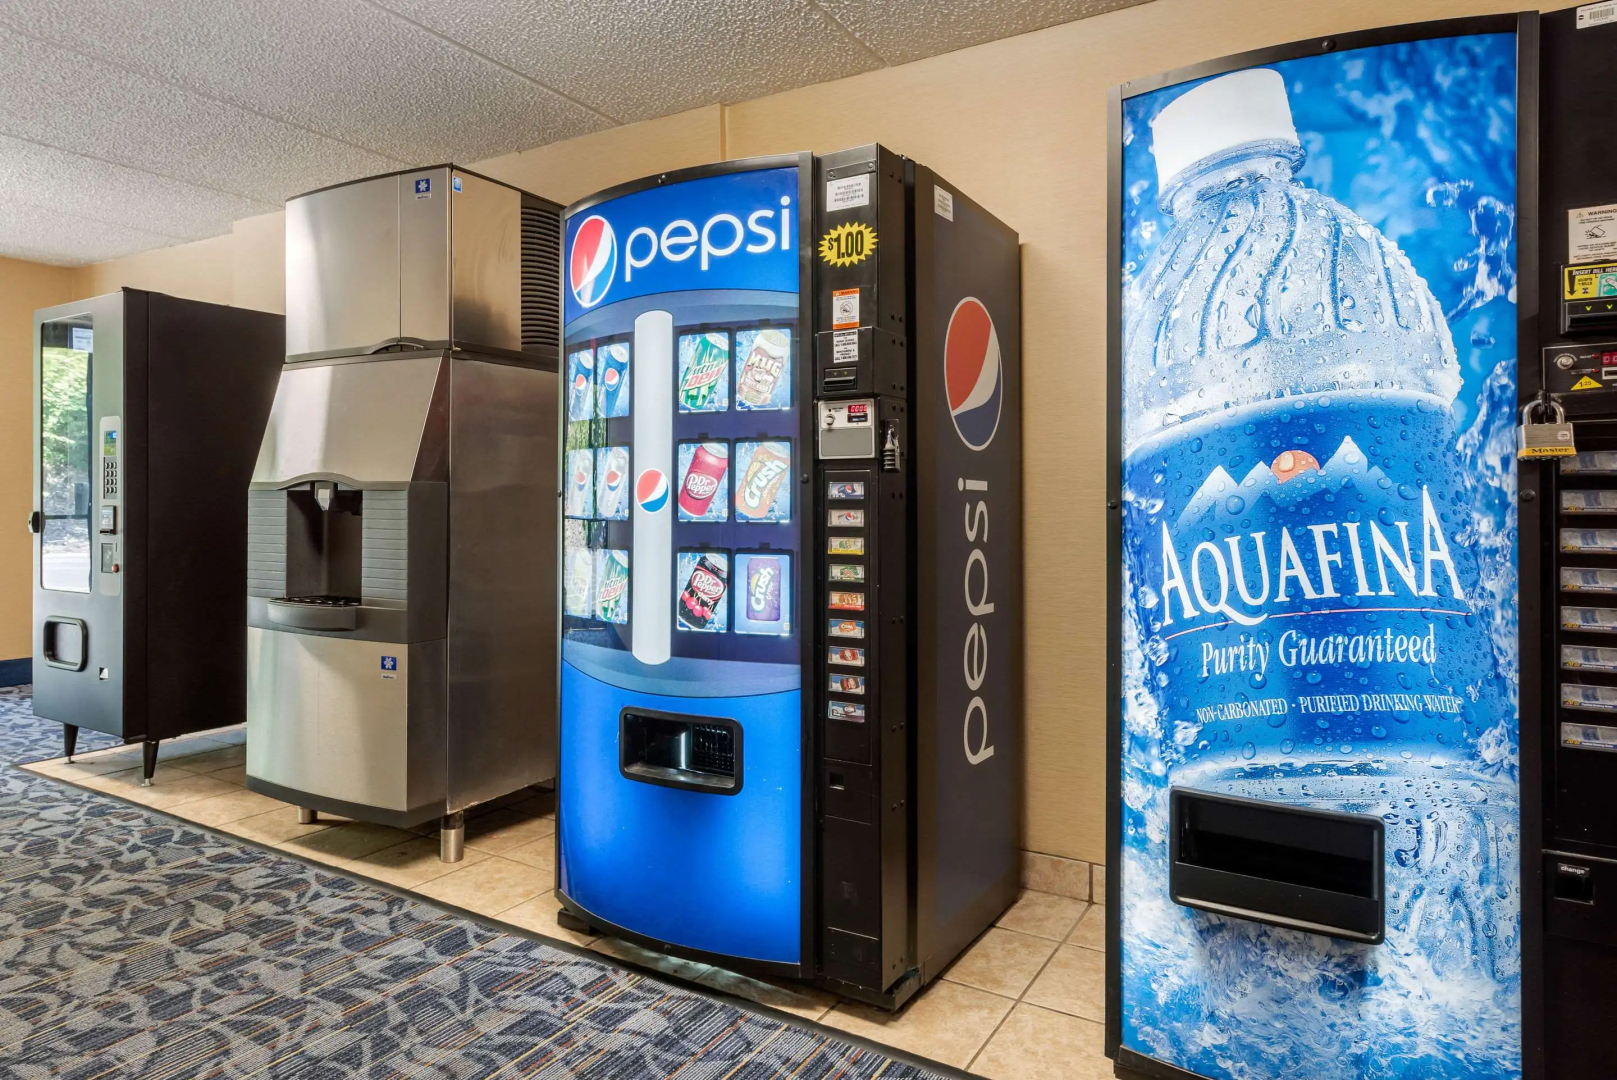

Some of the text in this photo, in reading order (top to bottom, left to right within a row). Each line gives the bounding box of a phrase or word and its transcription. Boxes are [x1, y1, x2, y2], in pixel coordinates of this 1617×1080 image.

[625, 195, 791, 283] pepsi
[828, 230, 864, 259] $1.00
[746, 351, 782, 378] MUG
[687, 473, 716, 494] Pepper
[744, 460, 789, 509] Crush
[1162, 485, 1465, 626] AQUAFINA
[692, 570, 721, 593] Pepper
[751, 567, 774, 611] Crush
[957, 477, 995, 765] pepsi
[1201, 624, 1437, 680] Purity Guaranteed
[1196, 694, 1461, 724] NON-CARBONATED PURIFIED DRINKING WATER
[1560, 865, 1585, 874] change
